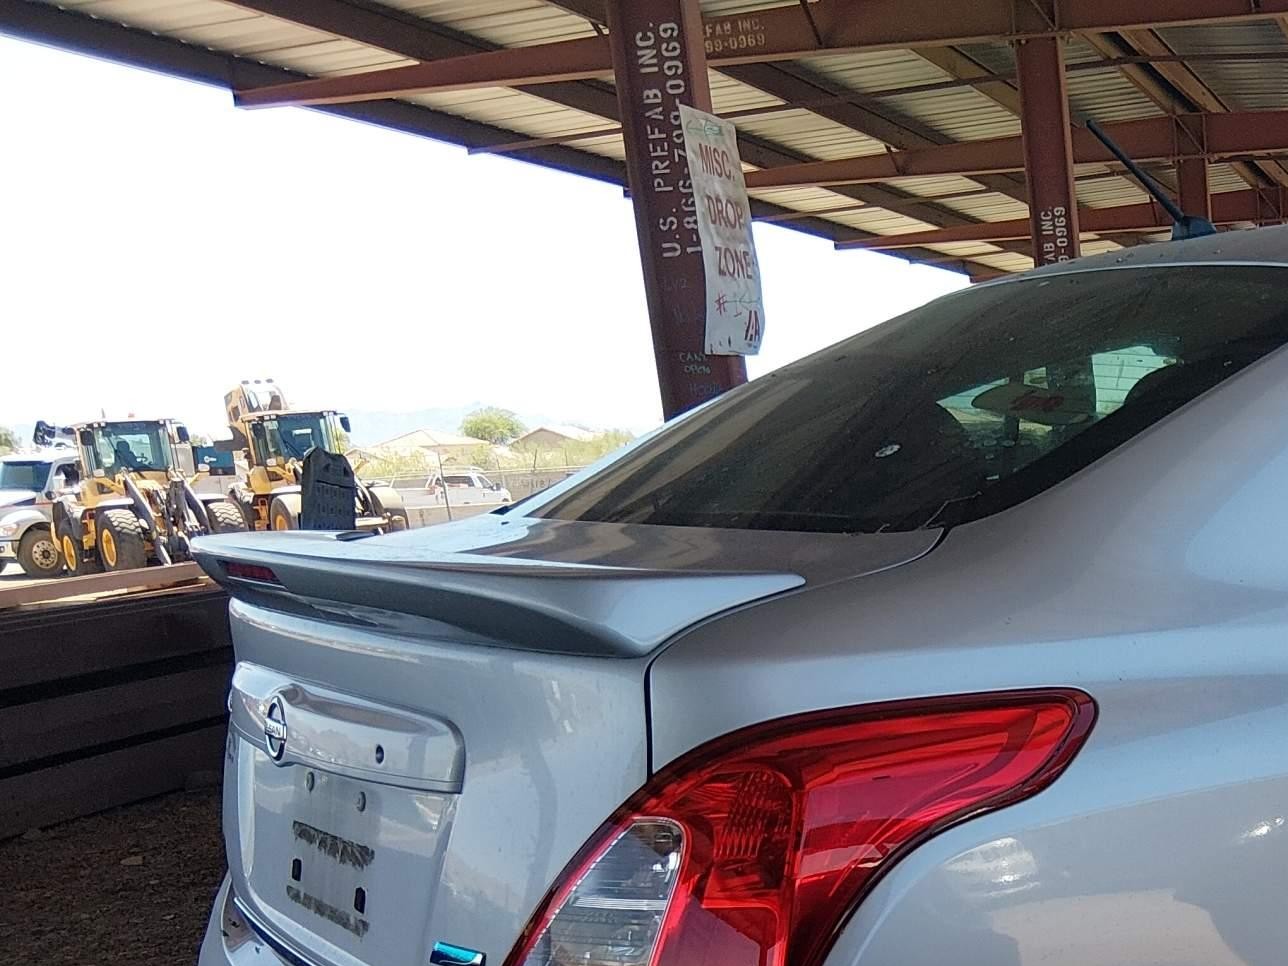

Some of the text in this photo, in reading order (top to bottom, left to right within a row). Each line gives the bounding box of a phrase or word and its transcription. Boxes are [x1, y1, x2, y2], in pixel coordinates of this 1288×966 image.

[635, 22, 659, 74] INC.
[643, 88, 674, 192] PREFAB
[698, 143, 736, 182] MISC.
[704, 194, 745, 231] DROP
[1040, 206, 1054, 235] INC.
[659, 207, 682, 258] U.S.
[714, 246, 753, 280] ZONE
